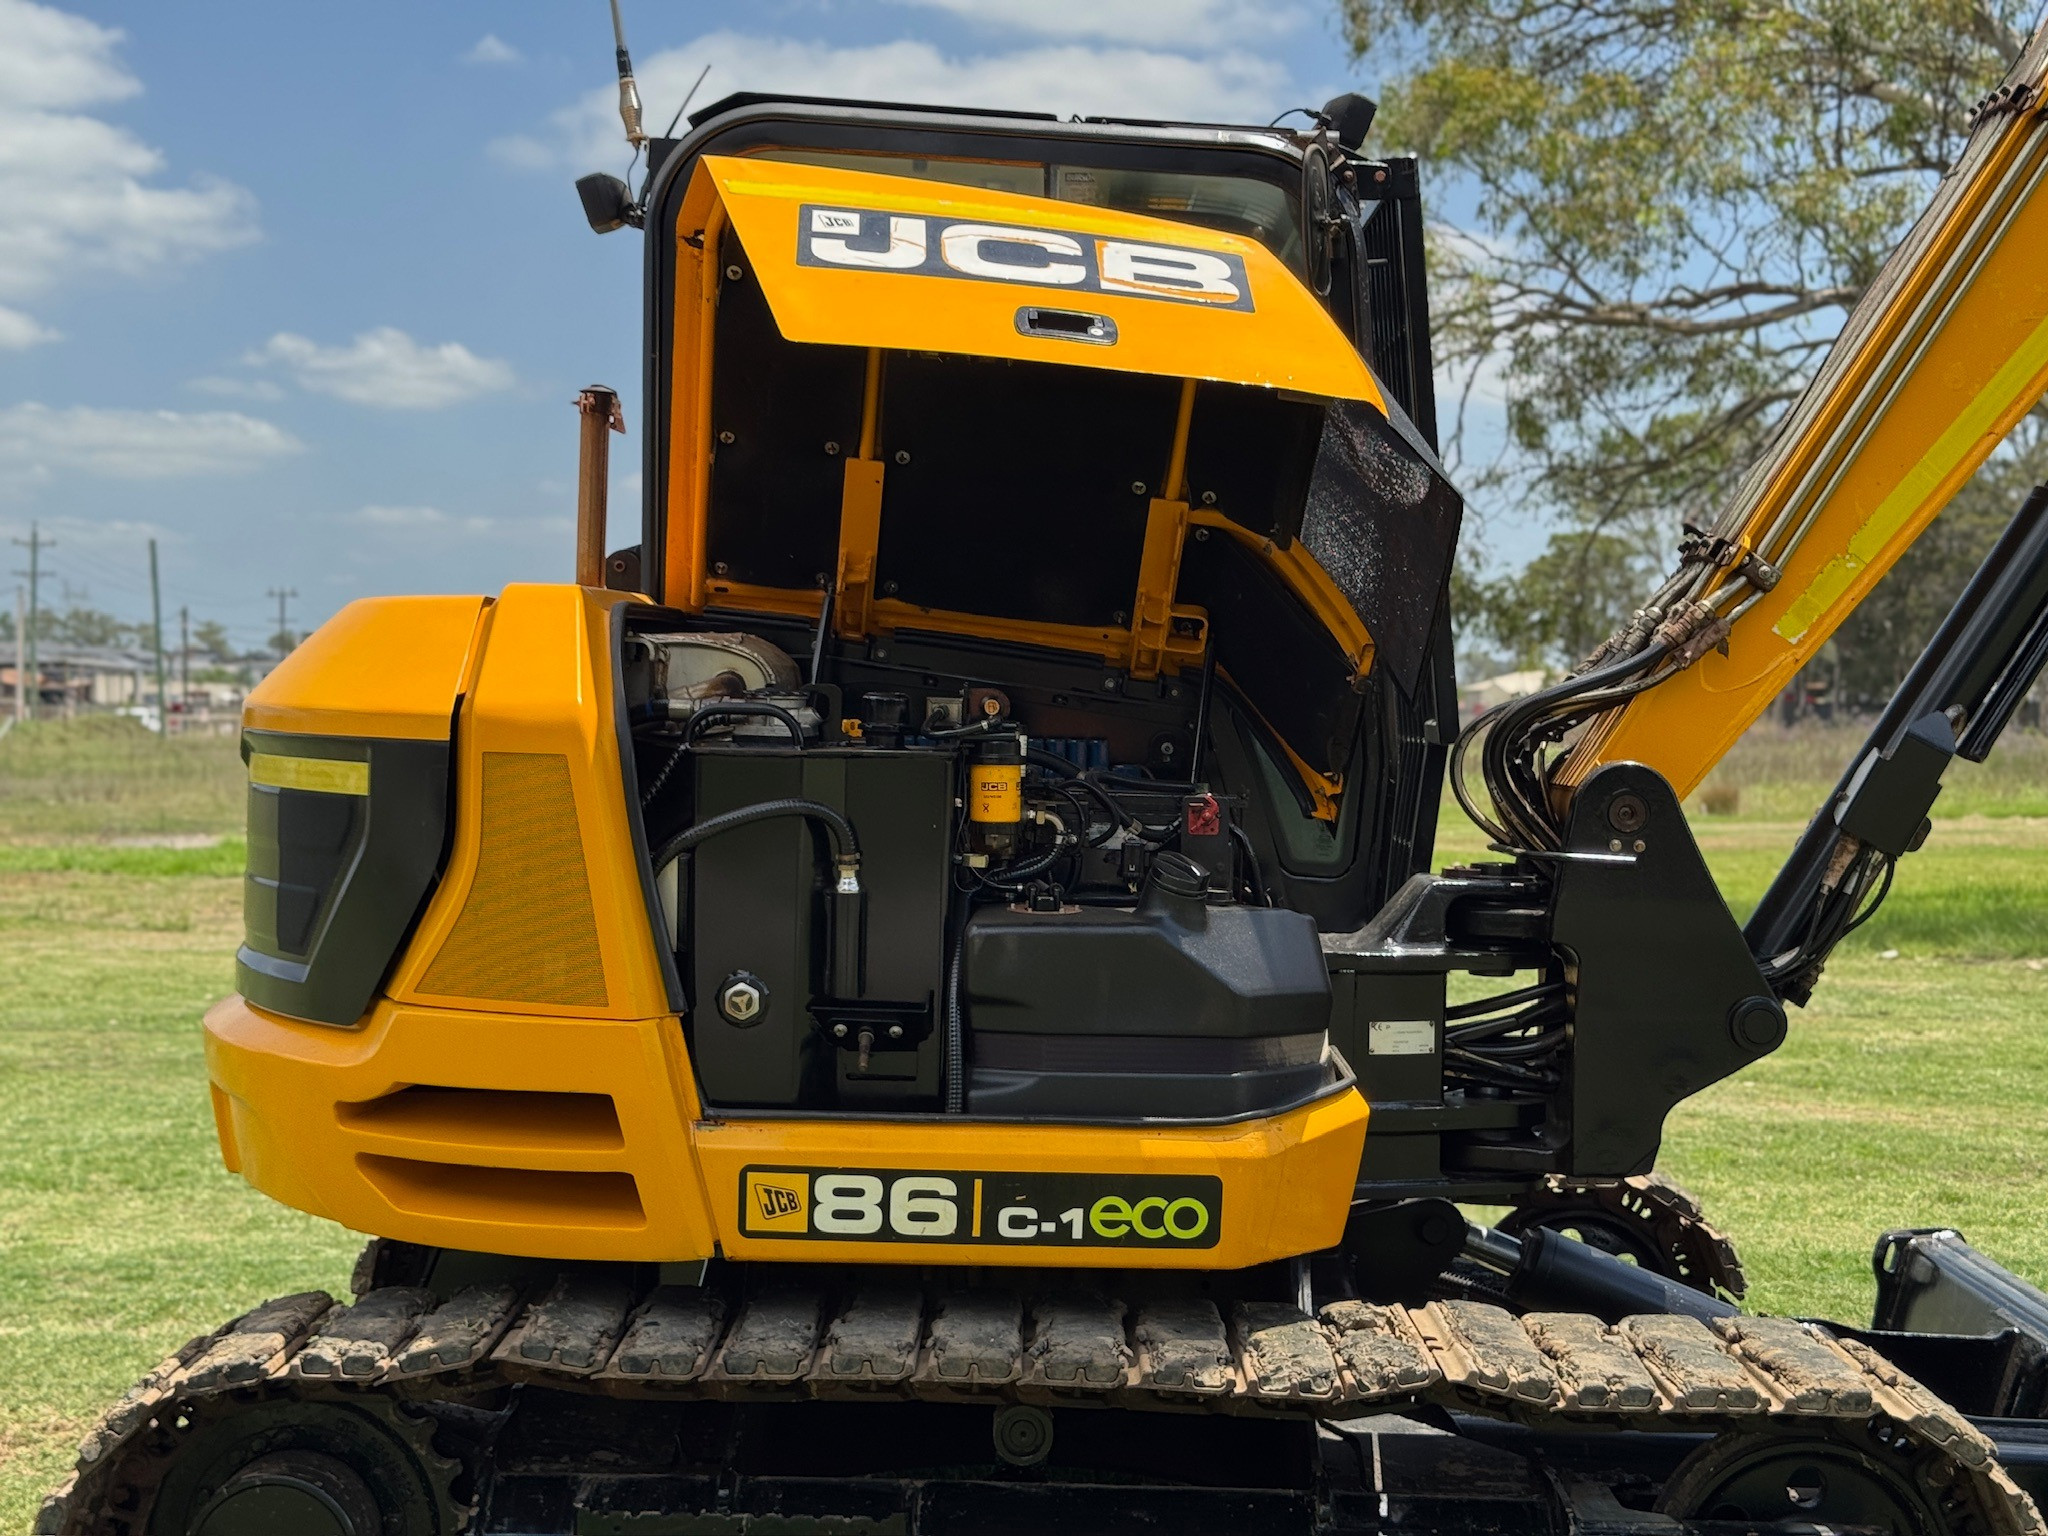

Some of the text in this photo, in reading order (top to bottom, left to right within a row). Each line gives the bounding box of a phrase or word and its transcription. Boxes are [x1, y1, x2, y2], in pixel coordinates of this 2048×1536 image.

[810, 214, 1240, 304] JCB
[981, 782, 1007, 791] JCB
[763, 1188, 798, 1215] JCB
[813, 1174, 1209, 1239] 86 C-1 eco
